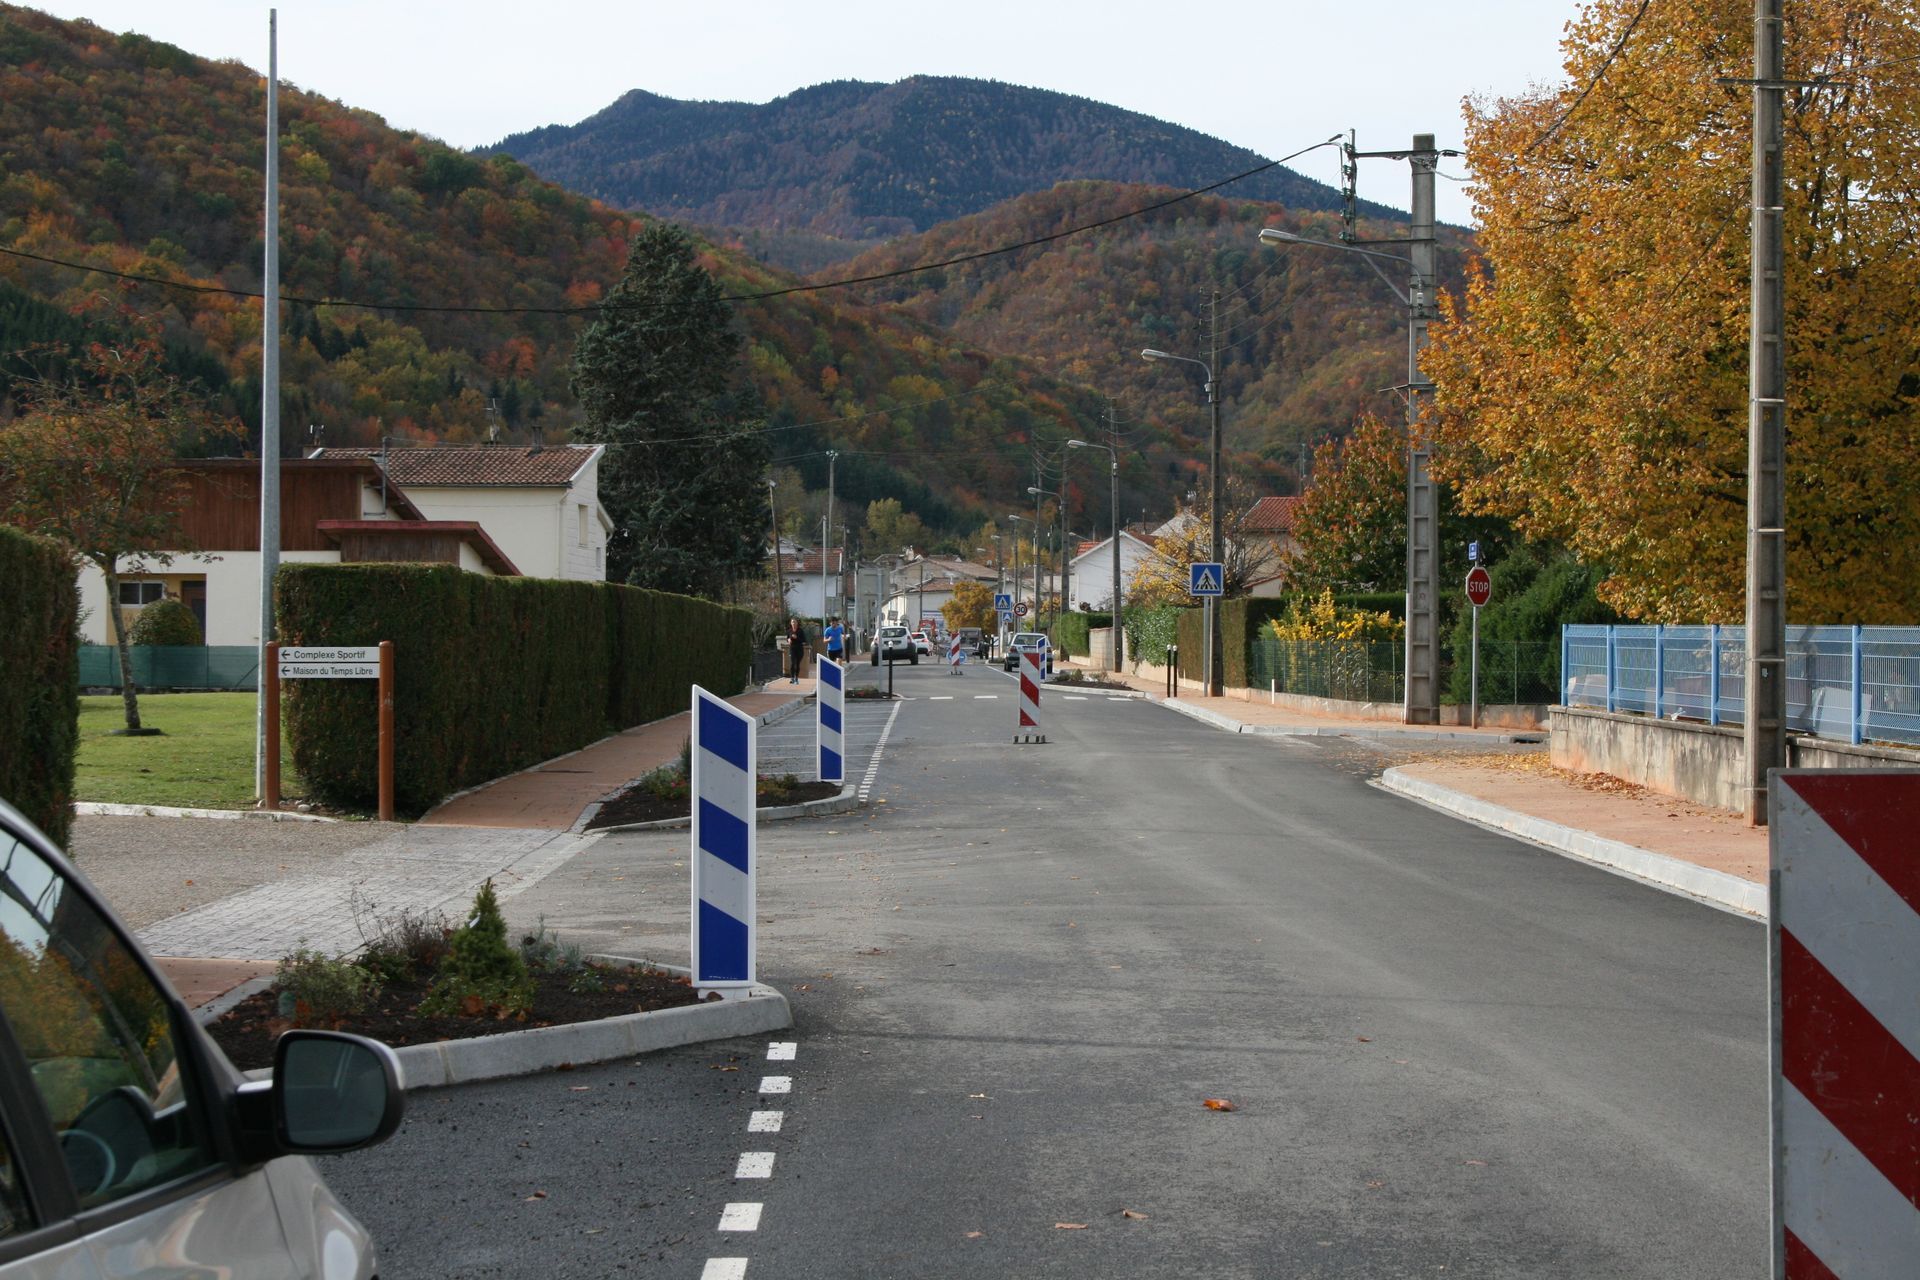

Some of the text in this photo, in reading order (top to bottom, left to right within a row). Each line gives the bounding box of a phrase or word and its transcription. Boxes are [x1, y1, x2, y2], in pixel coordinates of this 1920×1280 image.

[1469, 581, 1489, 593] STOP
[293, 650, 365, 660] Complexe Sportif
[293, 667, 373, 677] Maison du Temps Libre
